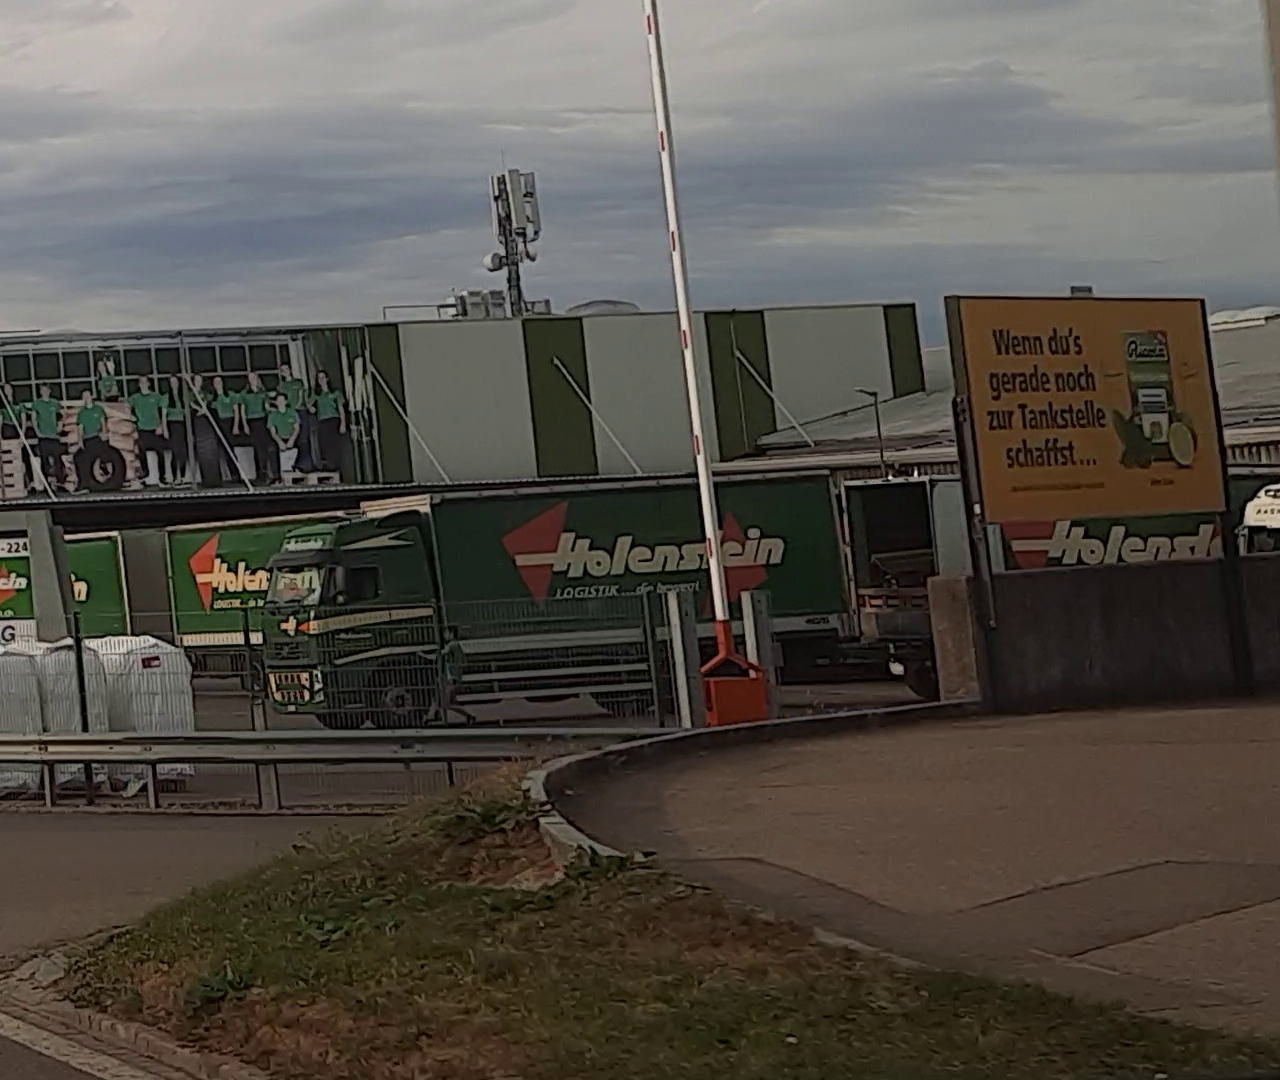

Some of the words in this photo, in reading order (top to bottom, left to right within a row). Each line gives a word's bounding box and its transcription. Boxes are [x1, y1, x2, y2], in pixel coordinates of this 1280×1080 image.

[993, 327, 1044, 356] Wenn
[1048, 327, 1083, 356] du's
[989, 364, 1051, 401] gerade
[1055, 363, 1096, 393] noch
[987, 409, 1014, 430] zur
[1018, 400, 1107, 430] Tankstelle
[514, 527, 786, 579] Holensein
